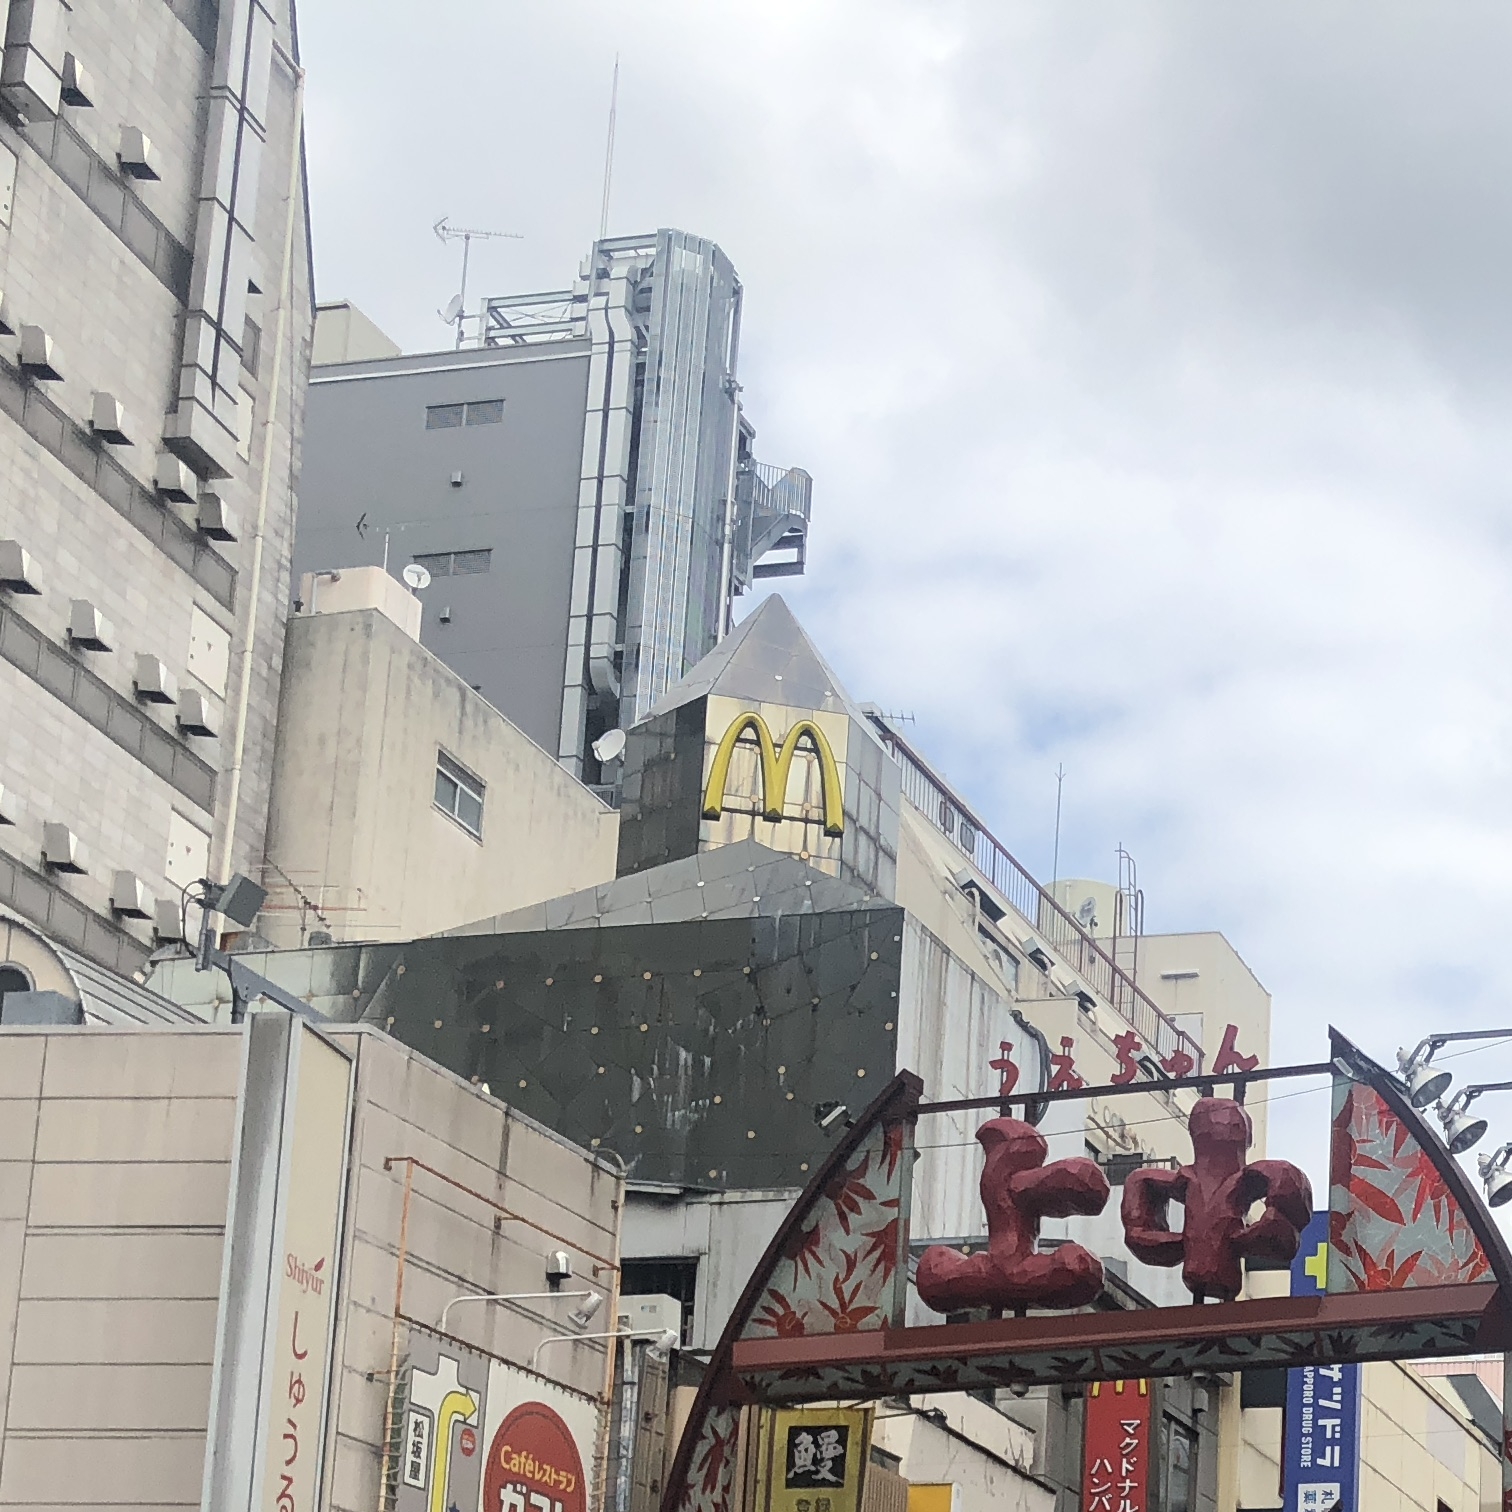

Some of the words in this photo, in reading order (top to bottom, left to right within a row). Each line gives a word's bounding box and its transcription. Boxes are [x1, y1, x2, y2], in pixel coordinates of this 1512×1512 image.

[990, 1023, 1259, 1098] うえちゅん
[1302, 1365, 1315, 1404] APPORO
[1302, 1406, 1314, 1434] DRUG
[1300, 1437, 1313, 1468] STORE
